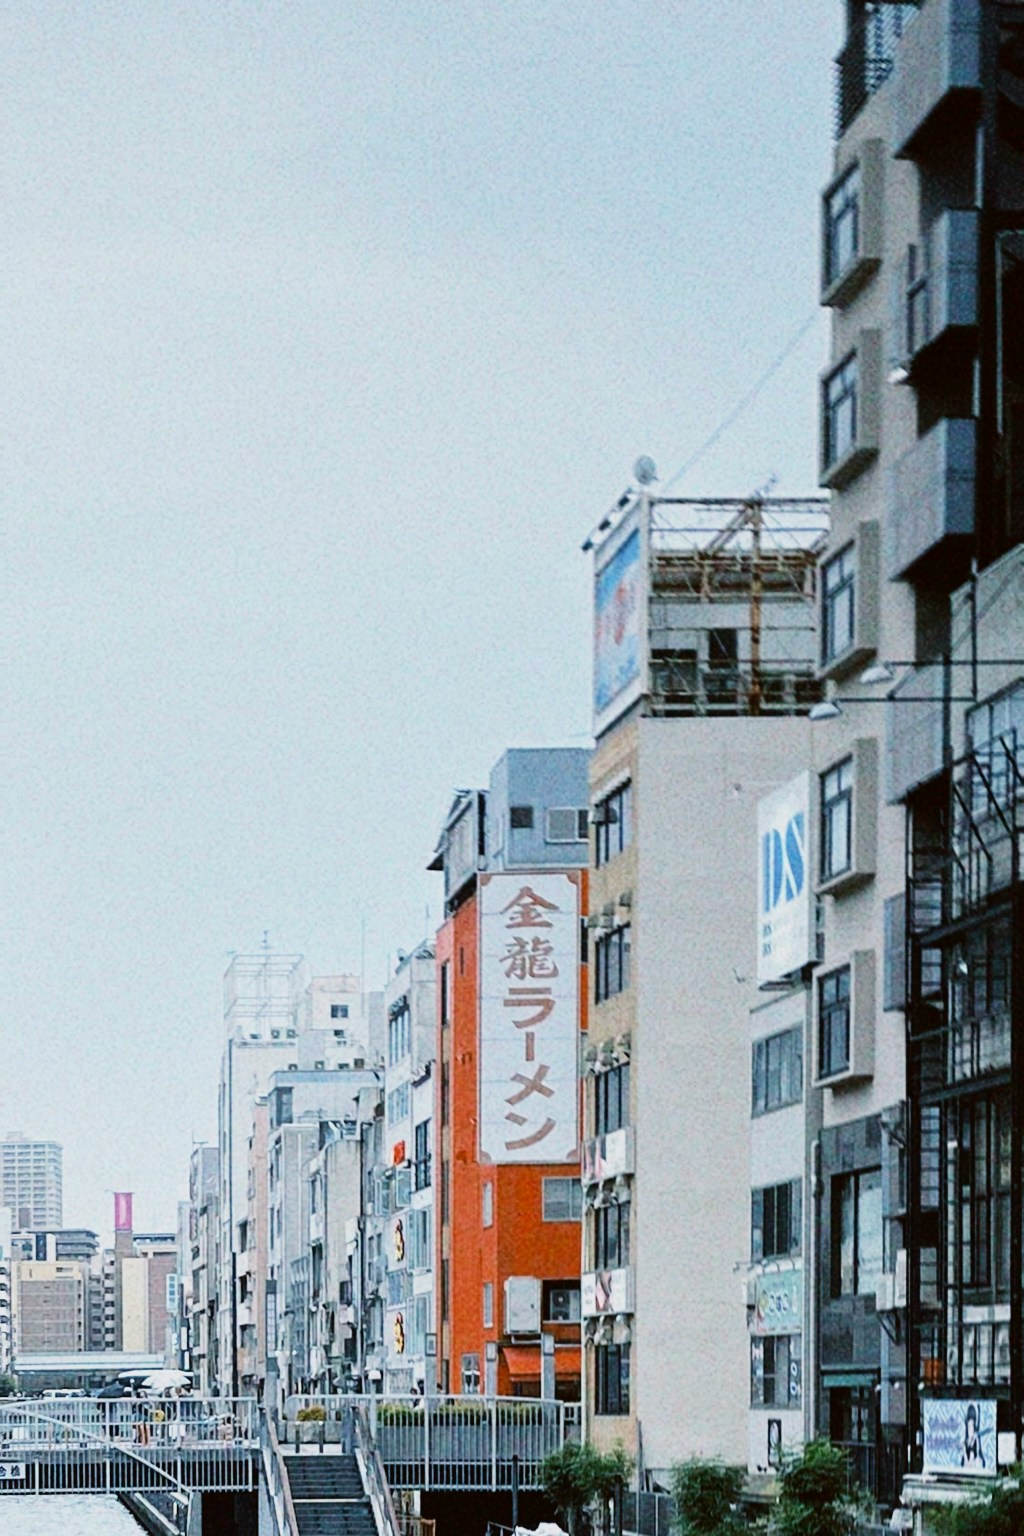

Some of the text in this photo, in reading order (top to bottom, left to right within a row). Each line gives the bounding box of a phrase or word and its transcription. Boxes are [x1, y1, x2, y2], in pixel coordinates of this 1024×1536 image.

[762, 811, 804, 913] DS
[499, 886, 560, 1150] 金龍ラーメン
